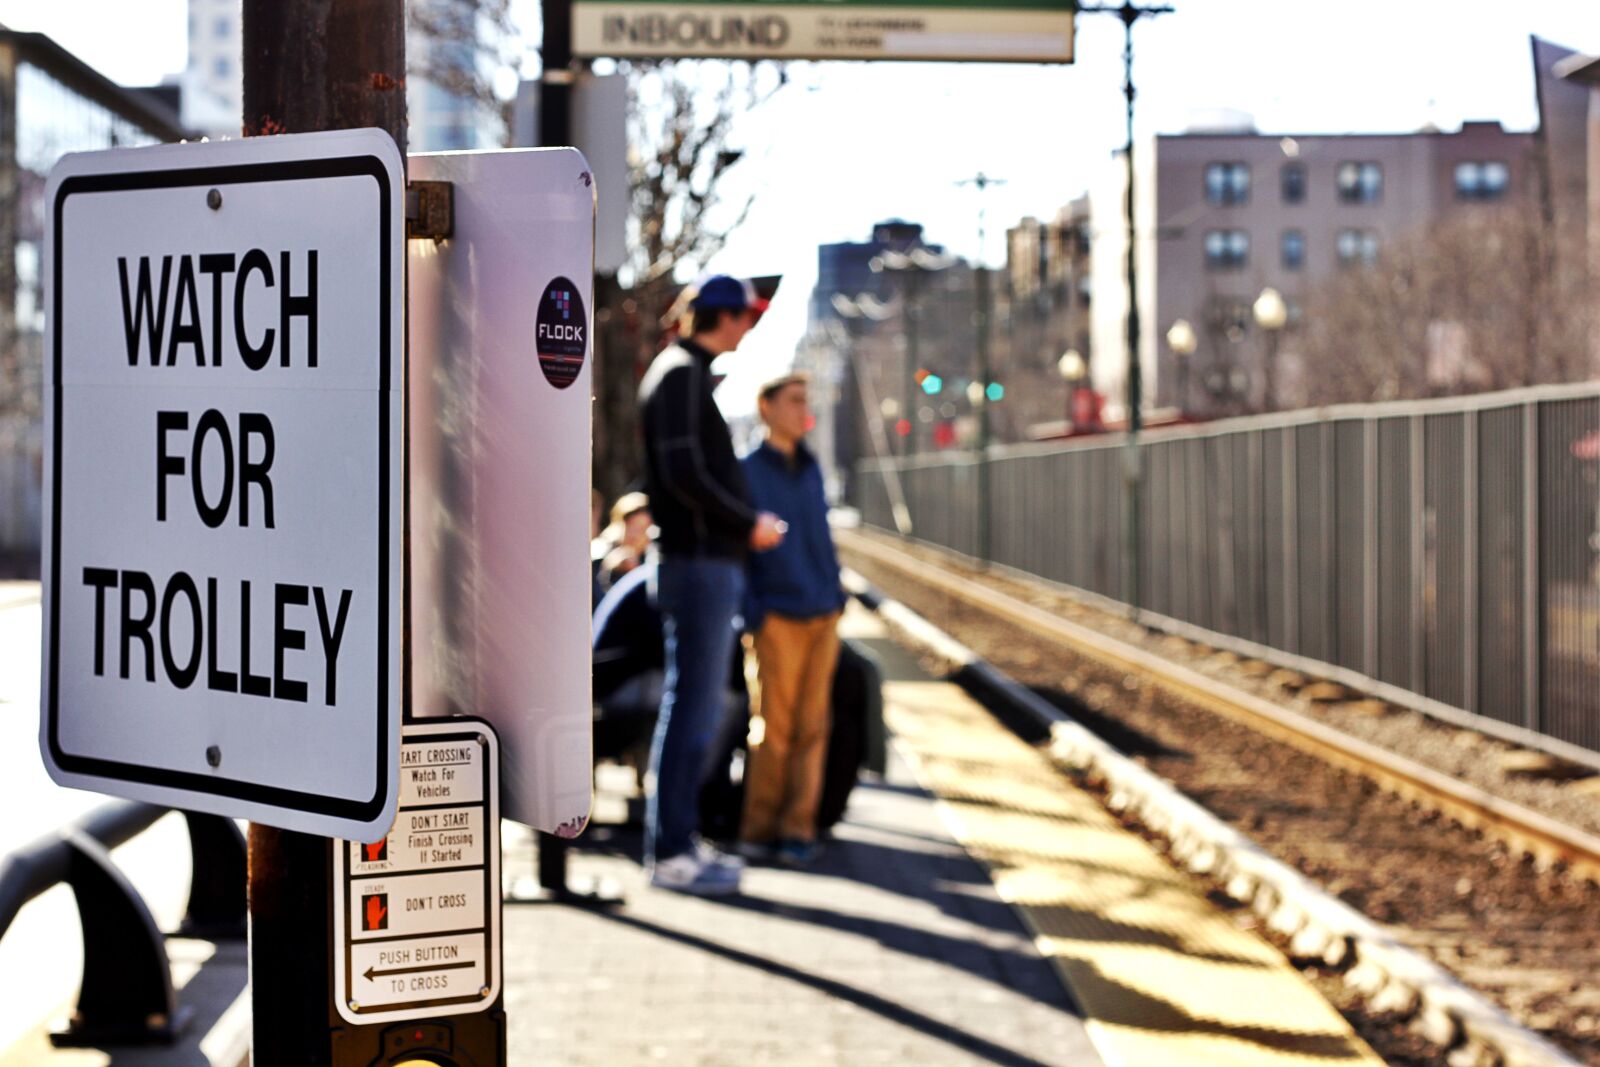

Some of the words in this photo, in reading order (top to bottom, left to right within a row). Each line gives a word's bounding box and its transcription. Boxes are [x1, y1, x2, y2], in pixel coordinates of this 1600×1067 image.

[602, 14, 790, 48] INBOUND
[117, 248, 319, 371] WATCH
[538, 323, 583, 341] FLOCK
[156, 408, 276, 529] FOR
[82, 566, 353, 707] TROLLEY
[401, 751, 422, 764] TART
[427, 748, 471, 763] CROSSING
[411, 768, 437, 782] Watch
[442, 767, 455, 780] For
[417, 785, 450, 798] Vehicles
[411, 815, 438, 829] DON'T
[443, 813, 469, 827] START
[408, 836, 433, 848] Finish
[438, 833, 473, 847] Crossing
[420, 852, 428, 863] If
[432, 849, 462, 862] Started
[406, 897, 433, 912] DON'T
[438, 894, 467, 909] CROSS
[379, 949, 410, 965] PUSH
[416, 945, 458, 961] BUTTON
[391, 980, 405, 993] TO
[410, 975, 448, 991] CROSS
